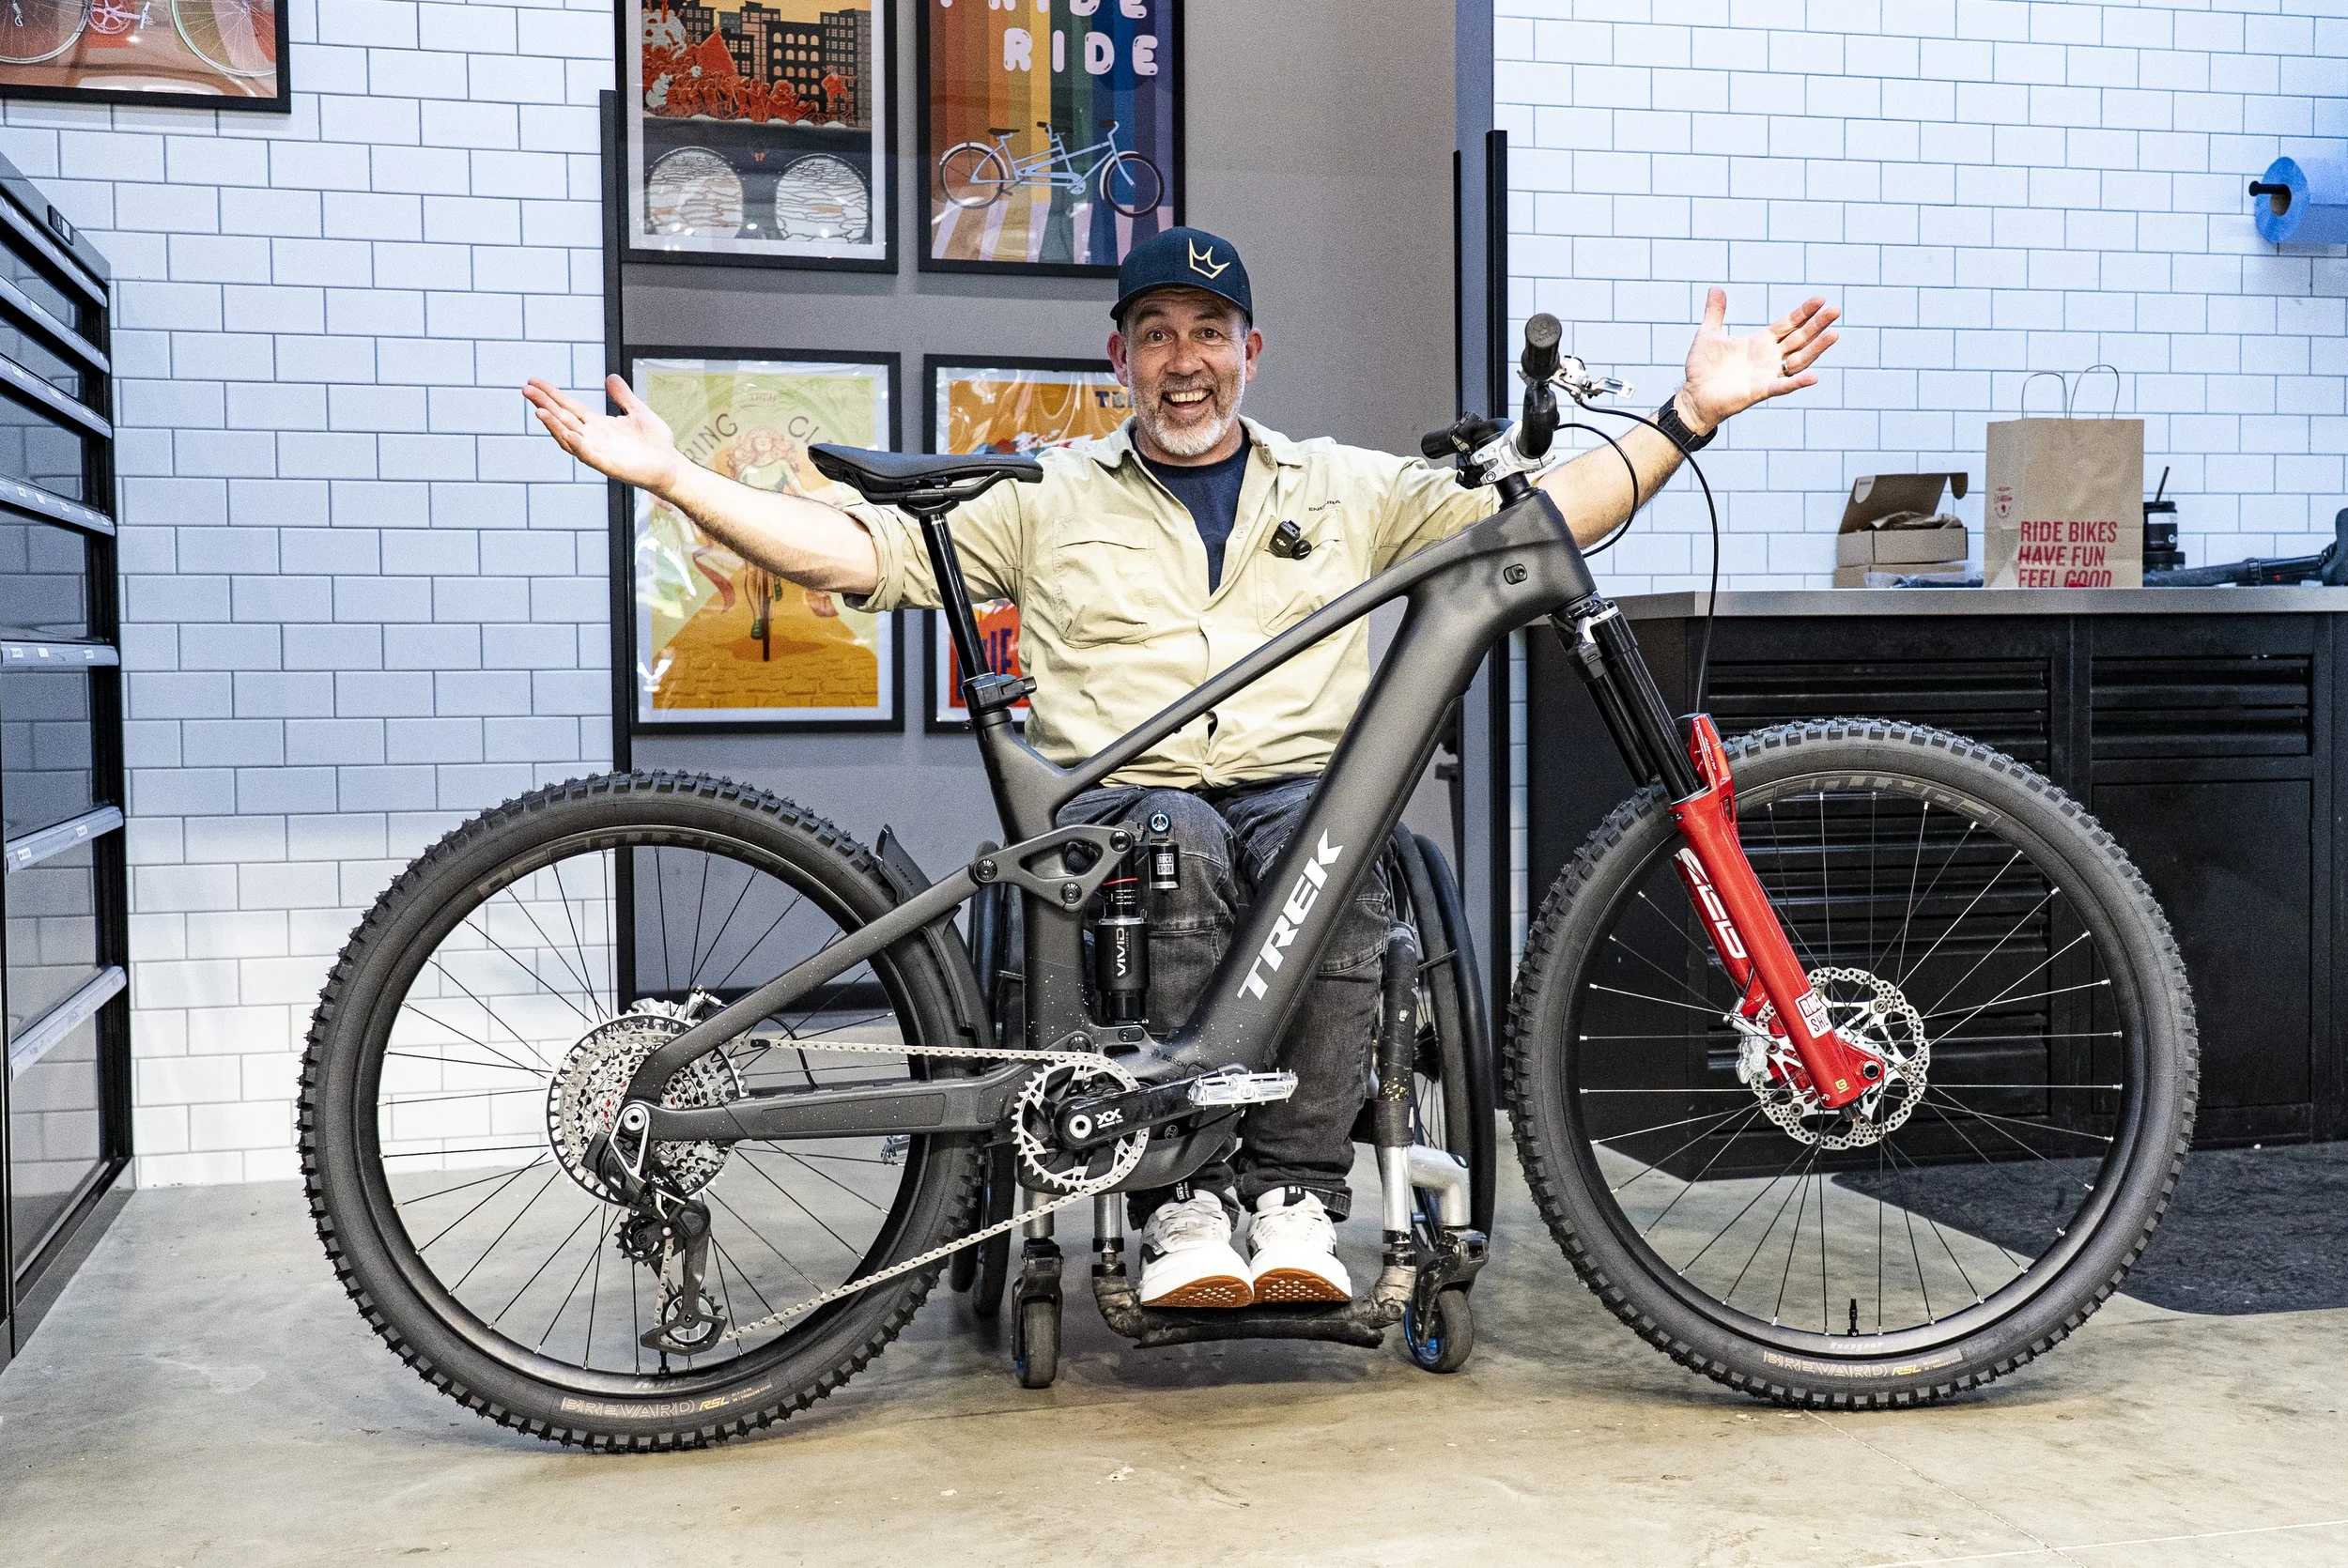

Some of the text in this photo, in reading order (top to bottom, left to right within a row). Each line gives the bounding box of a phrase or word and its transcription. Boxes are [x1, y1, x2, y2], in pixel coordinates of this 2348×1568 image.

[1004, 27, 1158, 76] RIDE
[684, 413, 738, 460] RING
[788, 416, 832, 446] CL
[2020, 521, 2117, 543] RIDE BIKES
[2017, 546, 2106, 566] HAVE FUN
[2018, 568, 2056, 588] FEEL
[1237, 827, 1344, 1001] TREK
[1116, 927, 1126, 976] VIVID
[1161, 1053, 1187, 1068] BOSCH
[1763, 1350, 1888, 1378] BREVARD
[1892, 1363, 1922, 1376] RSL
[562, 1396, 730, 1418] BREVARD RSL
